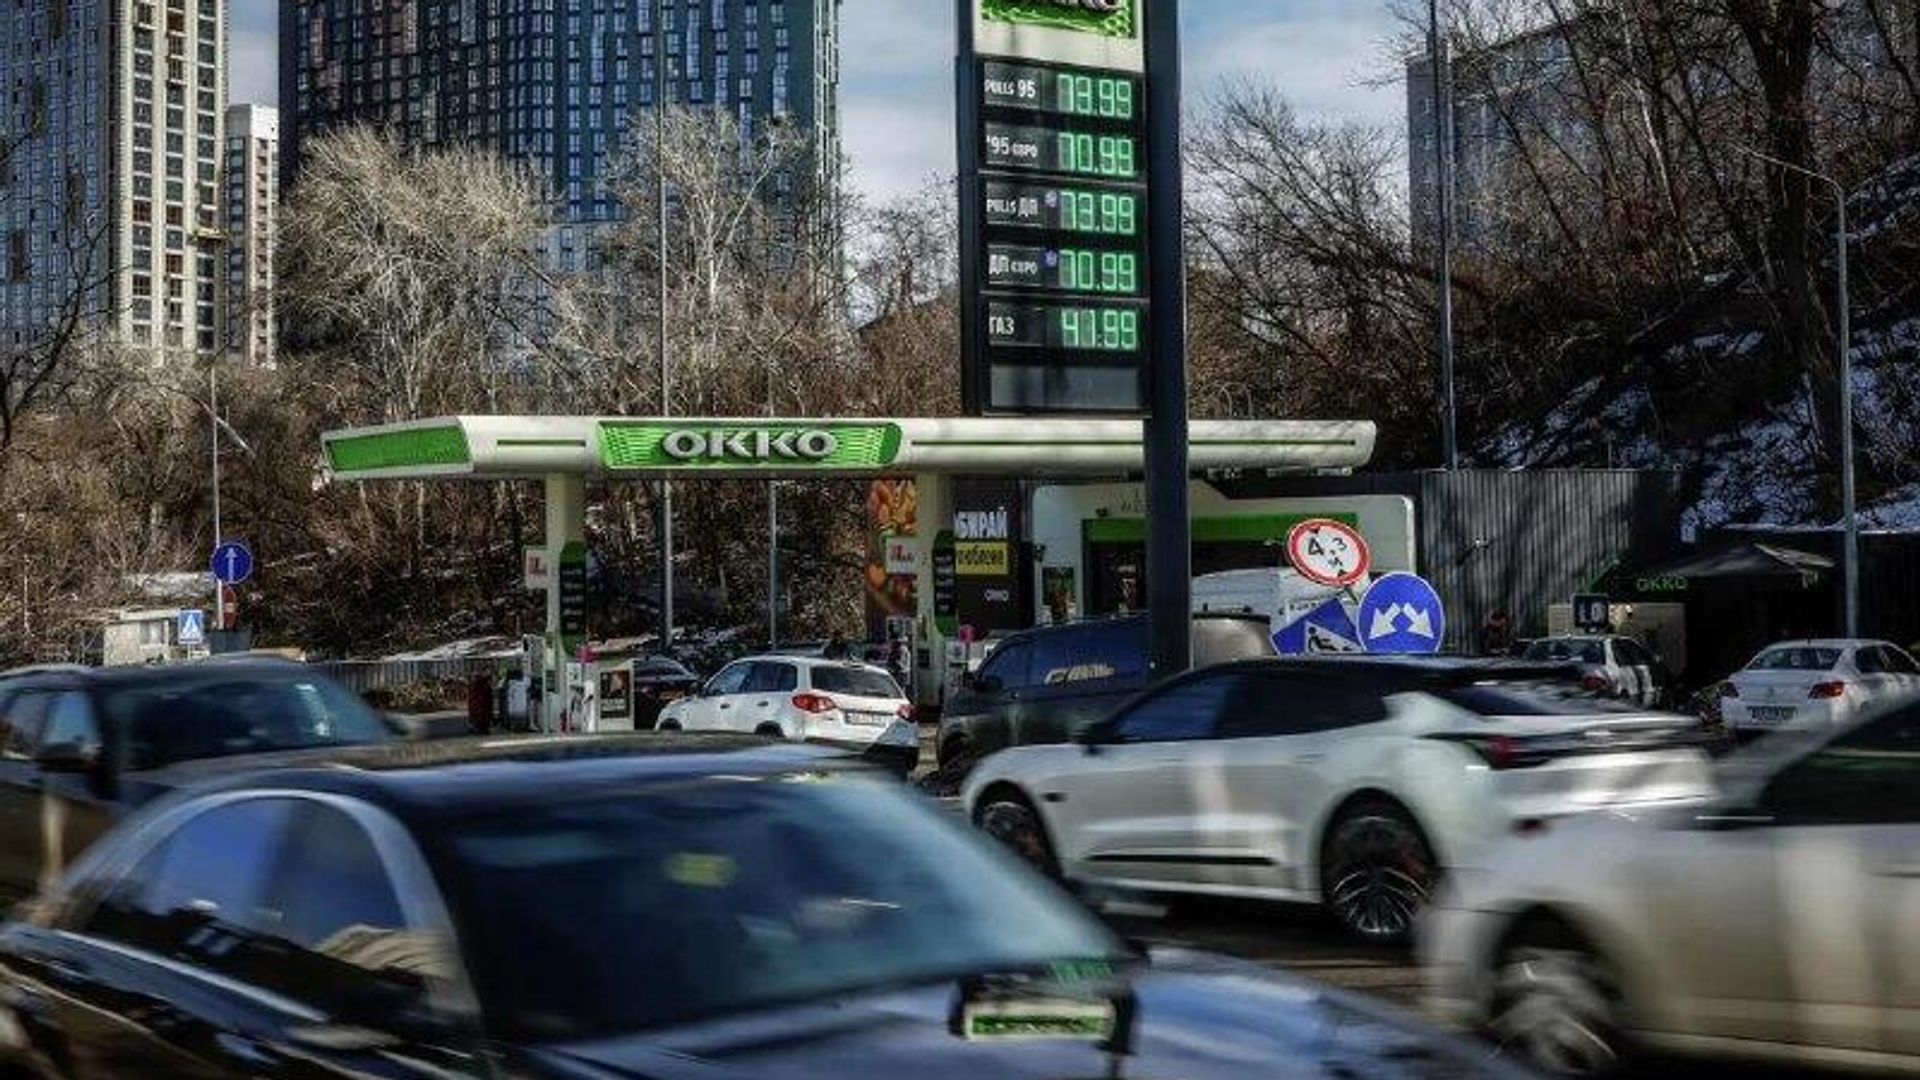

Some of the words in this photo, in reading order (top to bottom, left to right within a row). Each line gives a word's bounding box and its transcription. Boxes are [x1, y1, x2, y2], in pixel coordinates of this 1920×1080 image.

[985, 79, 1014, 95] PULLS
[1018, 79, 1036, 98] 95
[1057, 74, 1132, 119] 73.99
[1058, 132, 1134, 177] 70.99
[1060, 191, 1135, 235] 73.99
[1059, 249, 1136, 292] 70.99
[989, 316, 1015, 335] ГАЗ
[1061, 309, 1137, 349] 41.99
[662, 429, 838, 458] OKKO
[1636, 575, 1688, 591] OKKO
